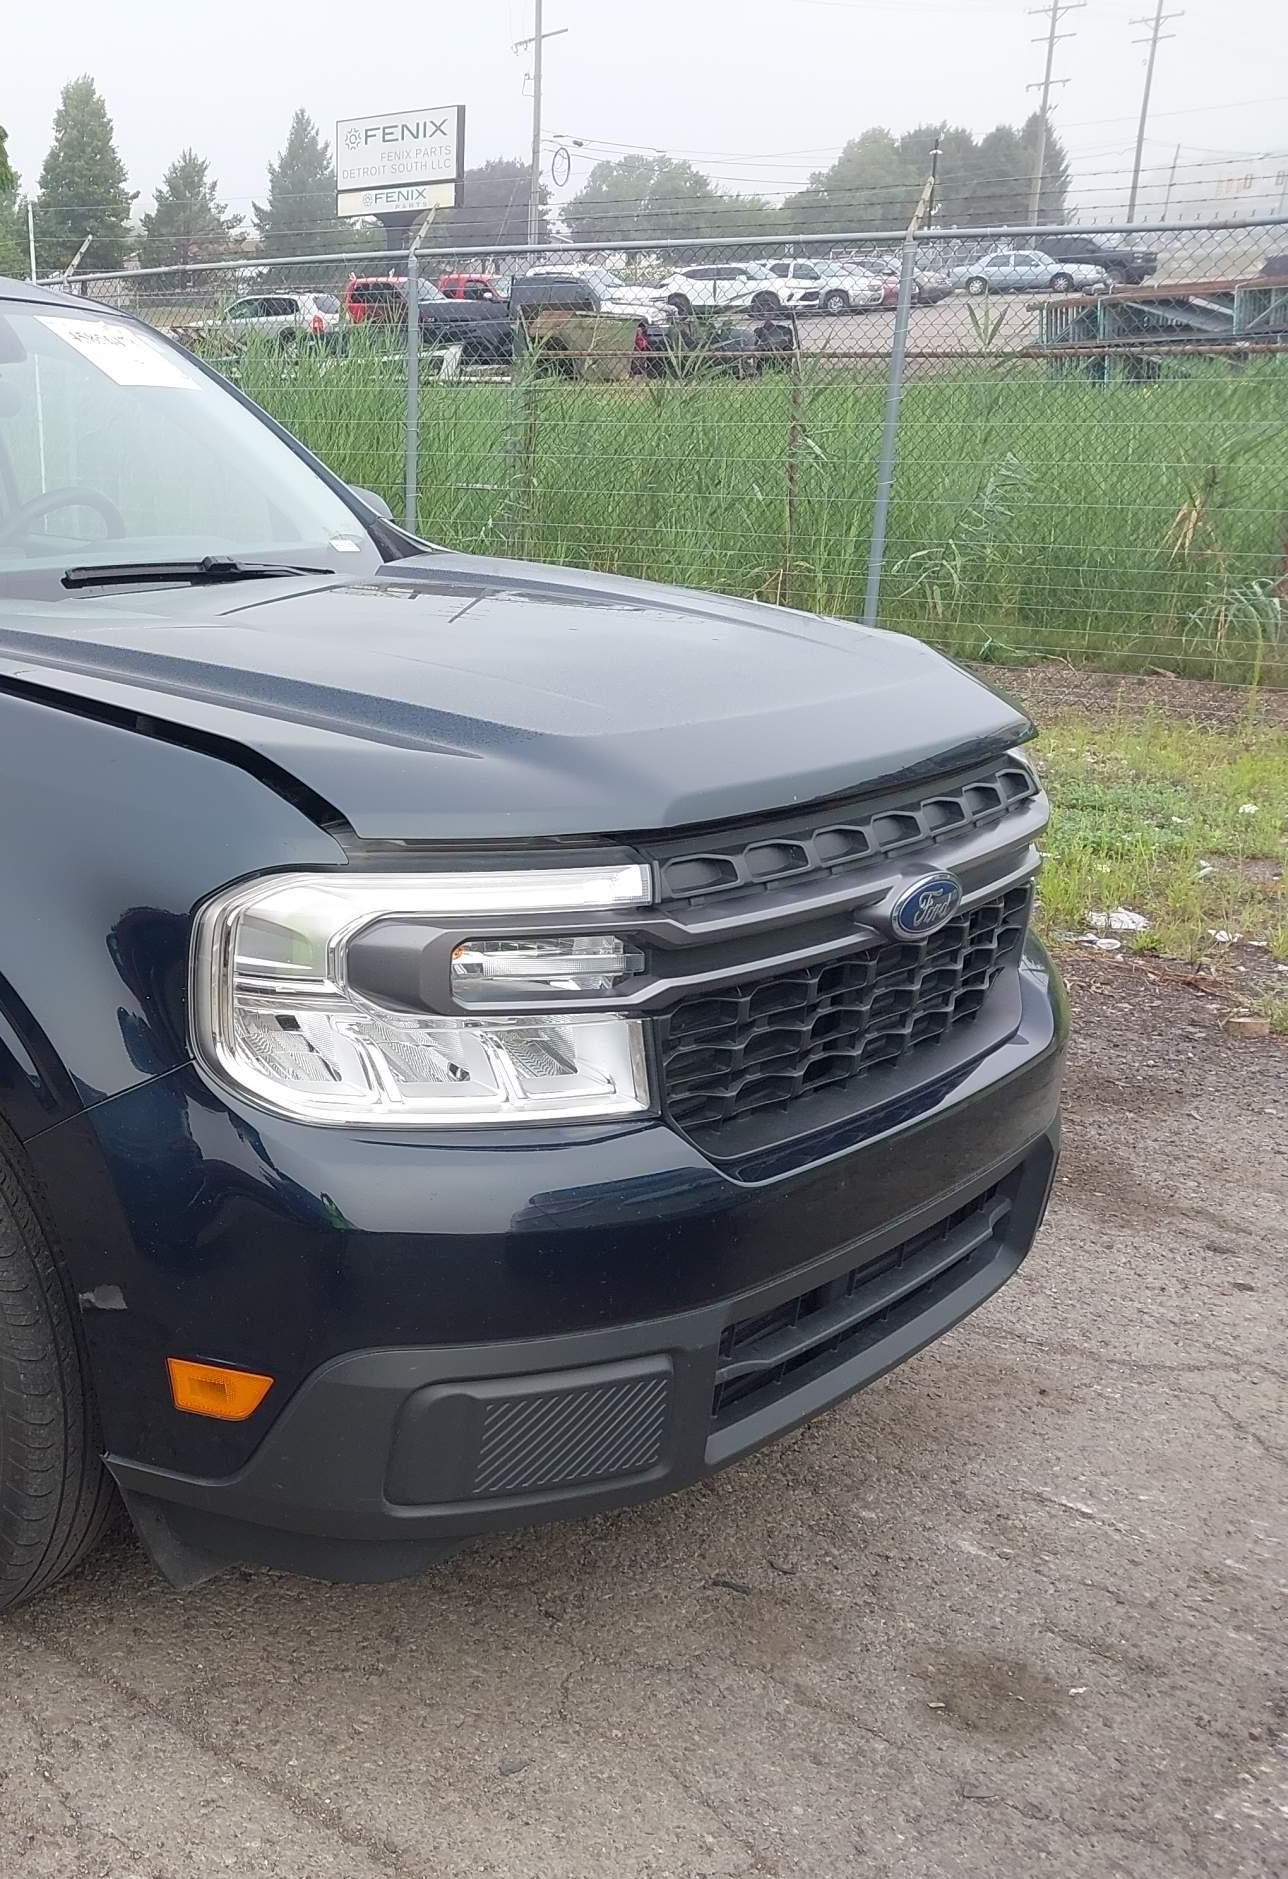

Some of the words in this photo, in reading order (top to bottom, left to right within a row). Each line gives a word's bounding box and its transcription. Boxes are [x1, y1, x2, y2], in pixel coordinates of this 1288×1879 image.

[364, 118, 449, 145] FENIX
[380, 150, 412, 162] FENIX
[415, 145, 452, 159] PARTS
[342, 165, 387, 180] DETROIT
[391, 160, 428, 175] SOUTH
[431, 158, 452, 170] LLC
[374, 187, 427, 204] FENIX
[913, 888, 953, 927] Ford
